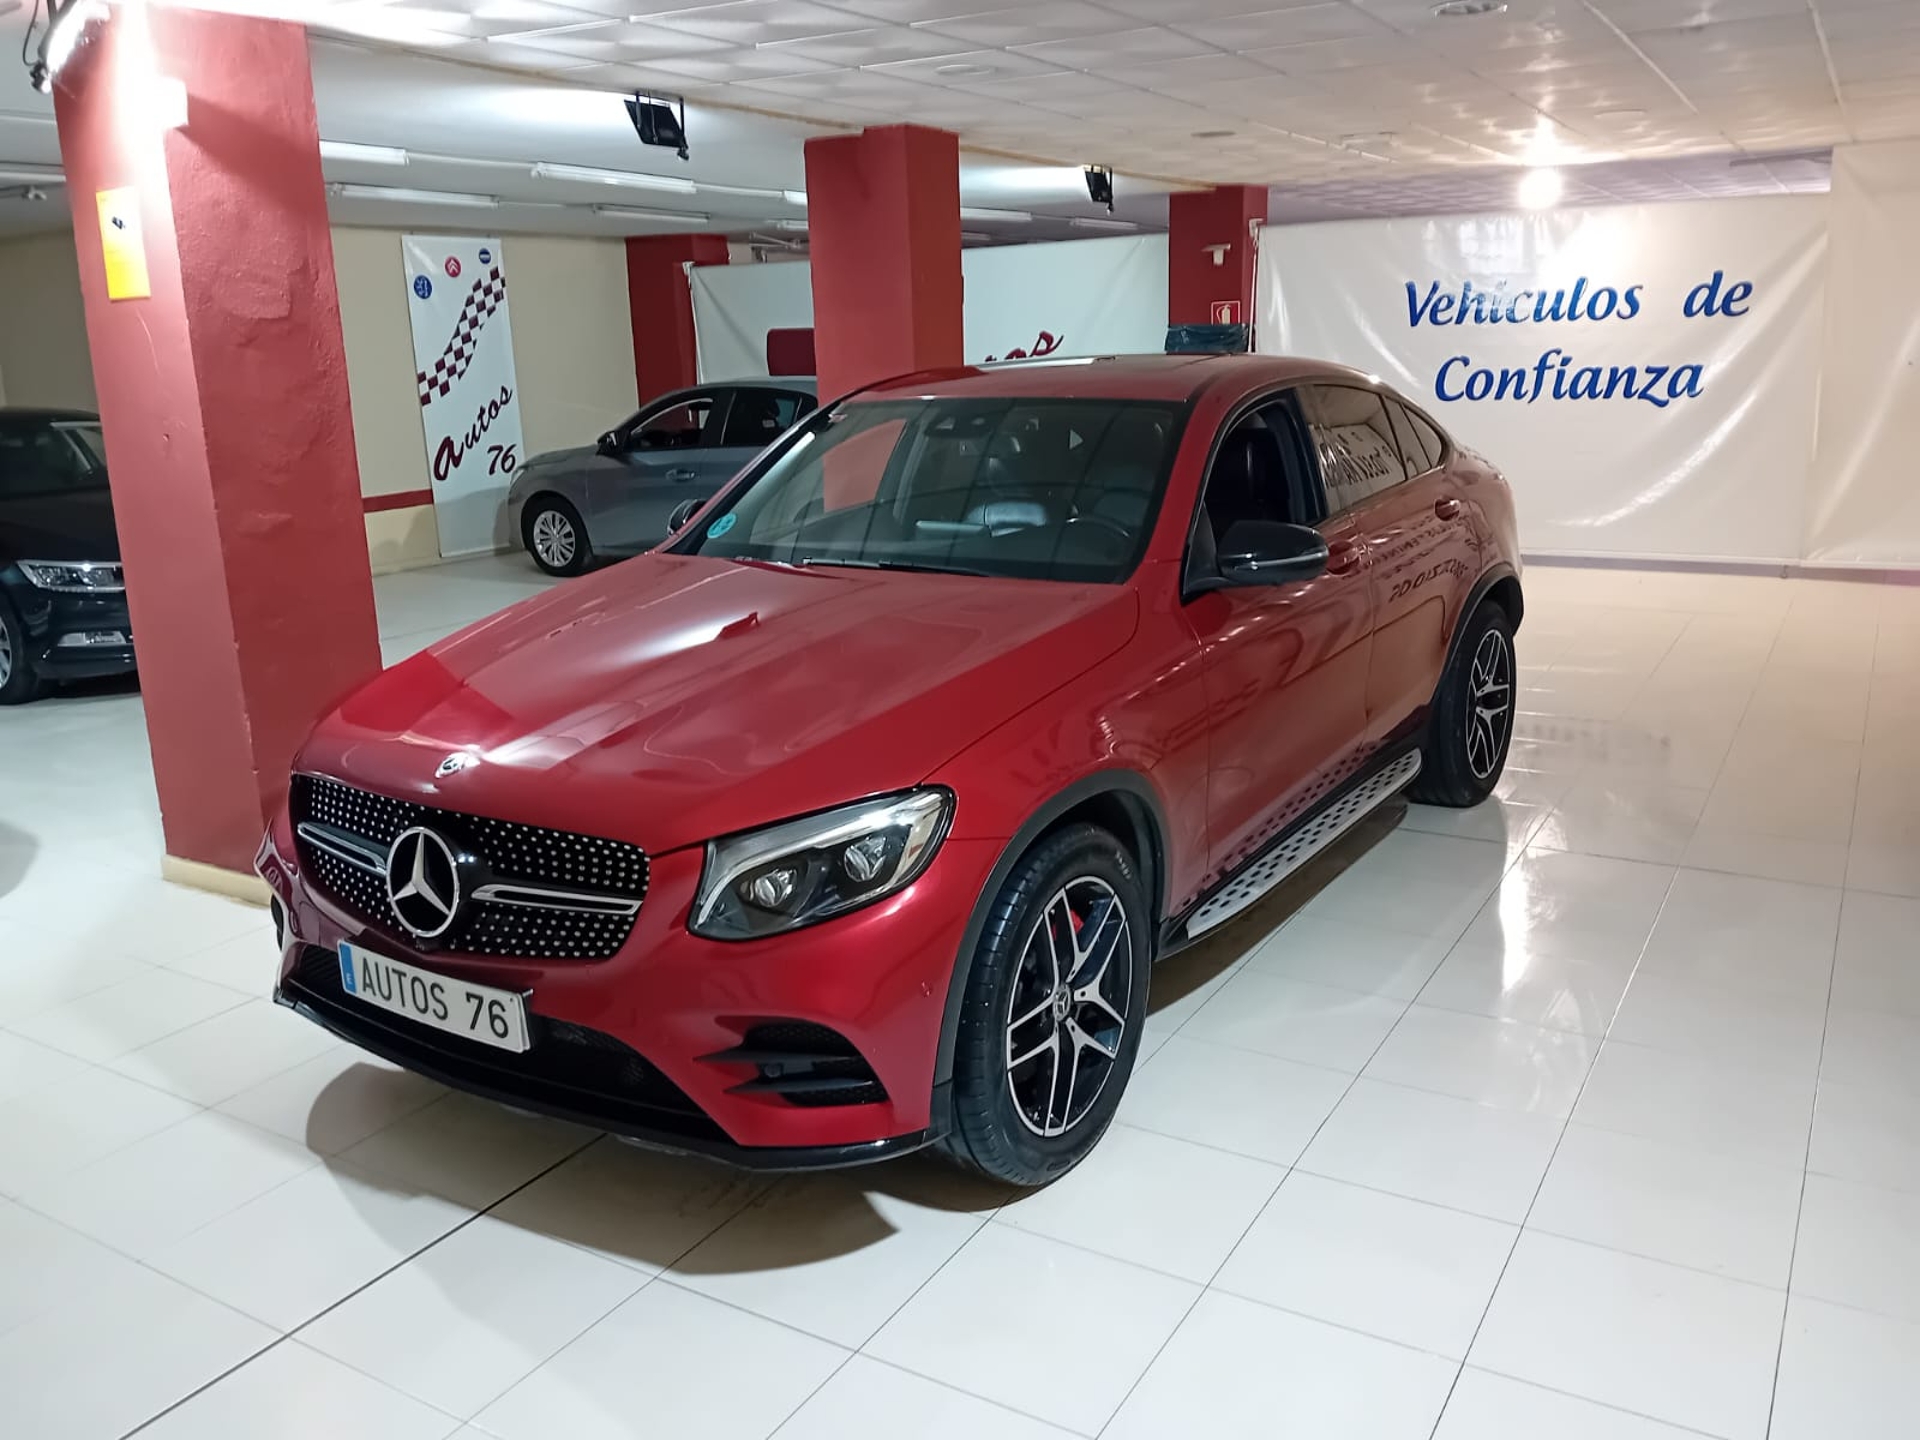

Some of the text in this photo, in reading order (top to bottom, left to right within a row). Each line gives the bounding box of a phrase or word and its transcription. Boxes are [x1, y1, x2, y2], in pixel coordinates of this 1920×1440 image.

[1683, 270, 1753, 318] de
[1435, 348, 1704, 408] Confianza
[433, 385, 513, 481] Autos
[487, 444, 517, 476] 76
[362, 957, 509, 1039] AUTOS 76
